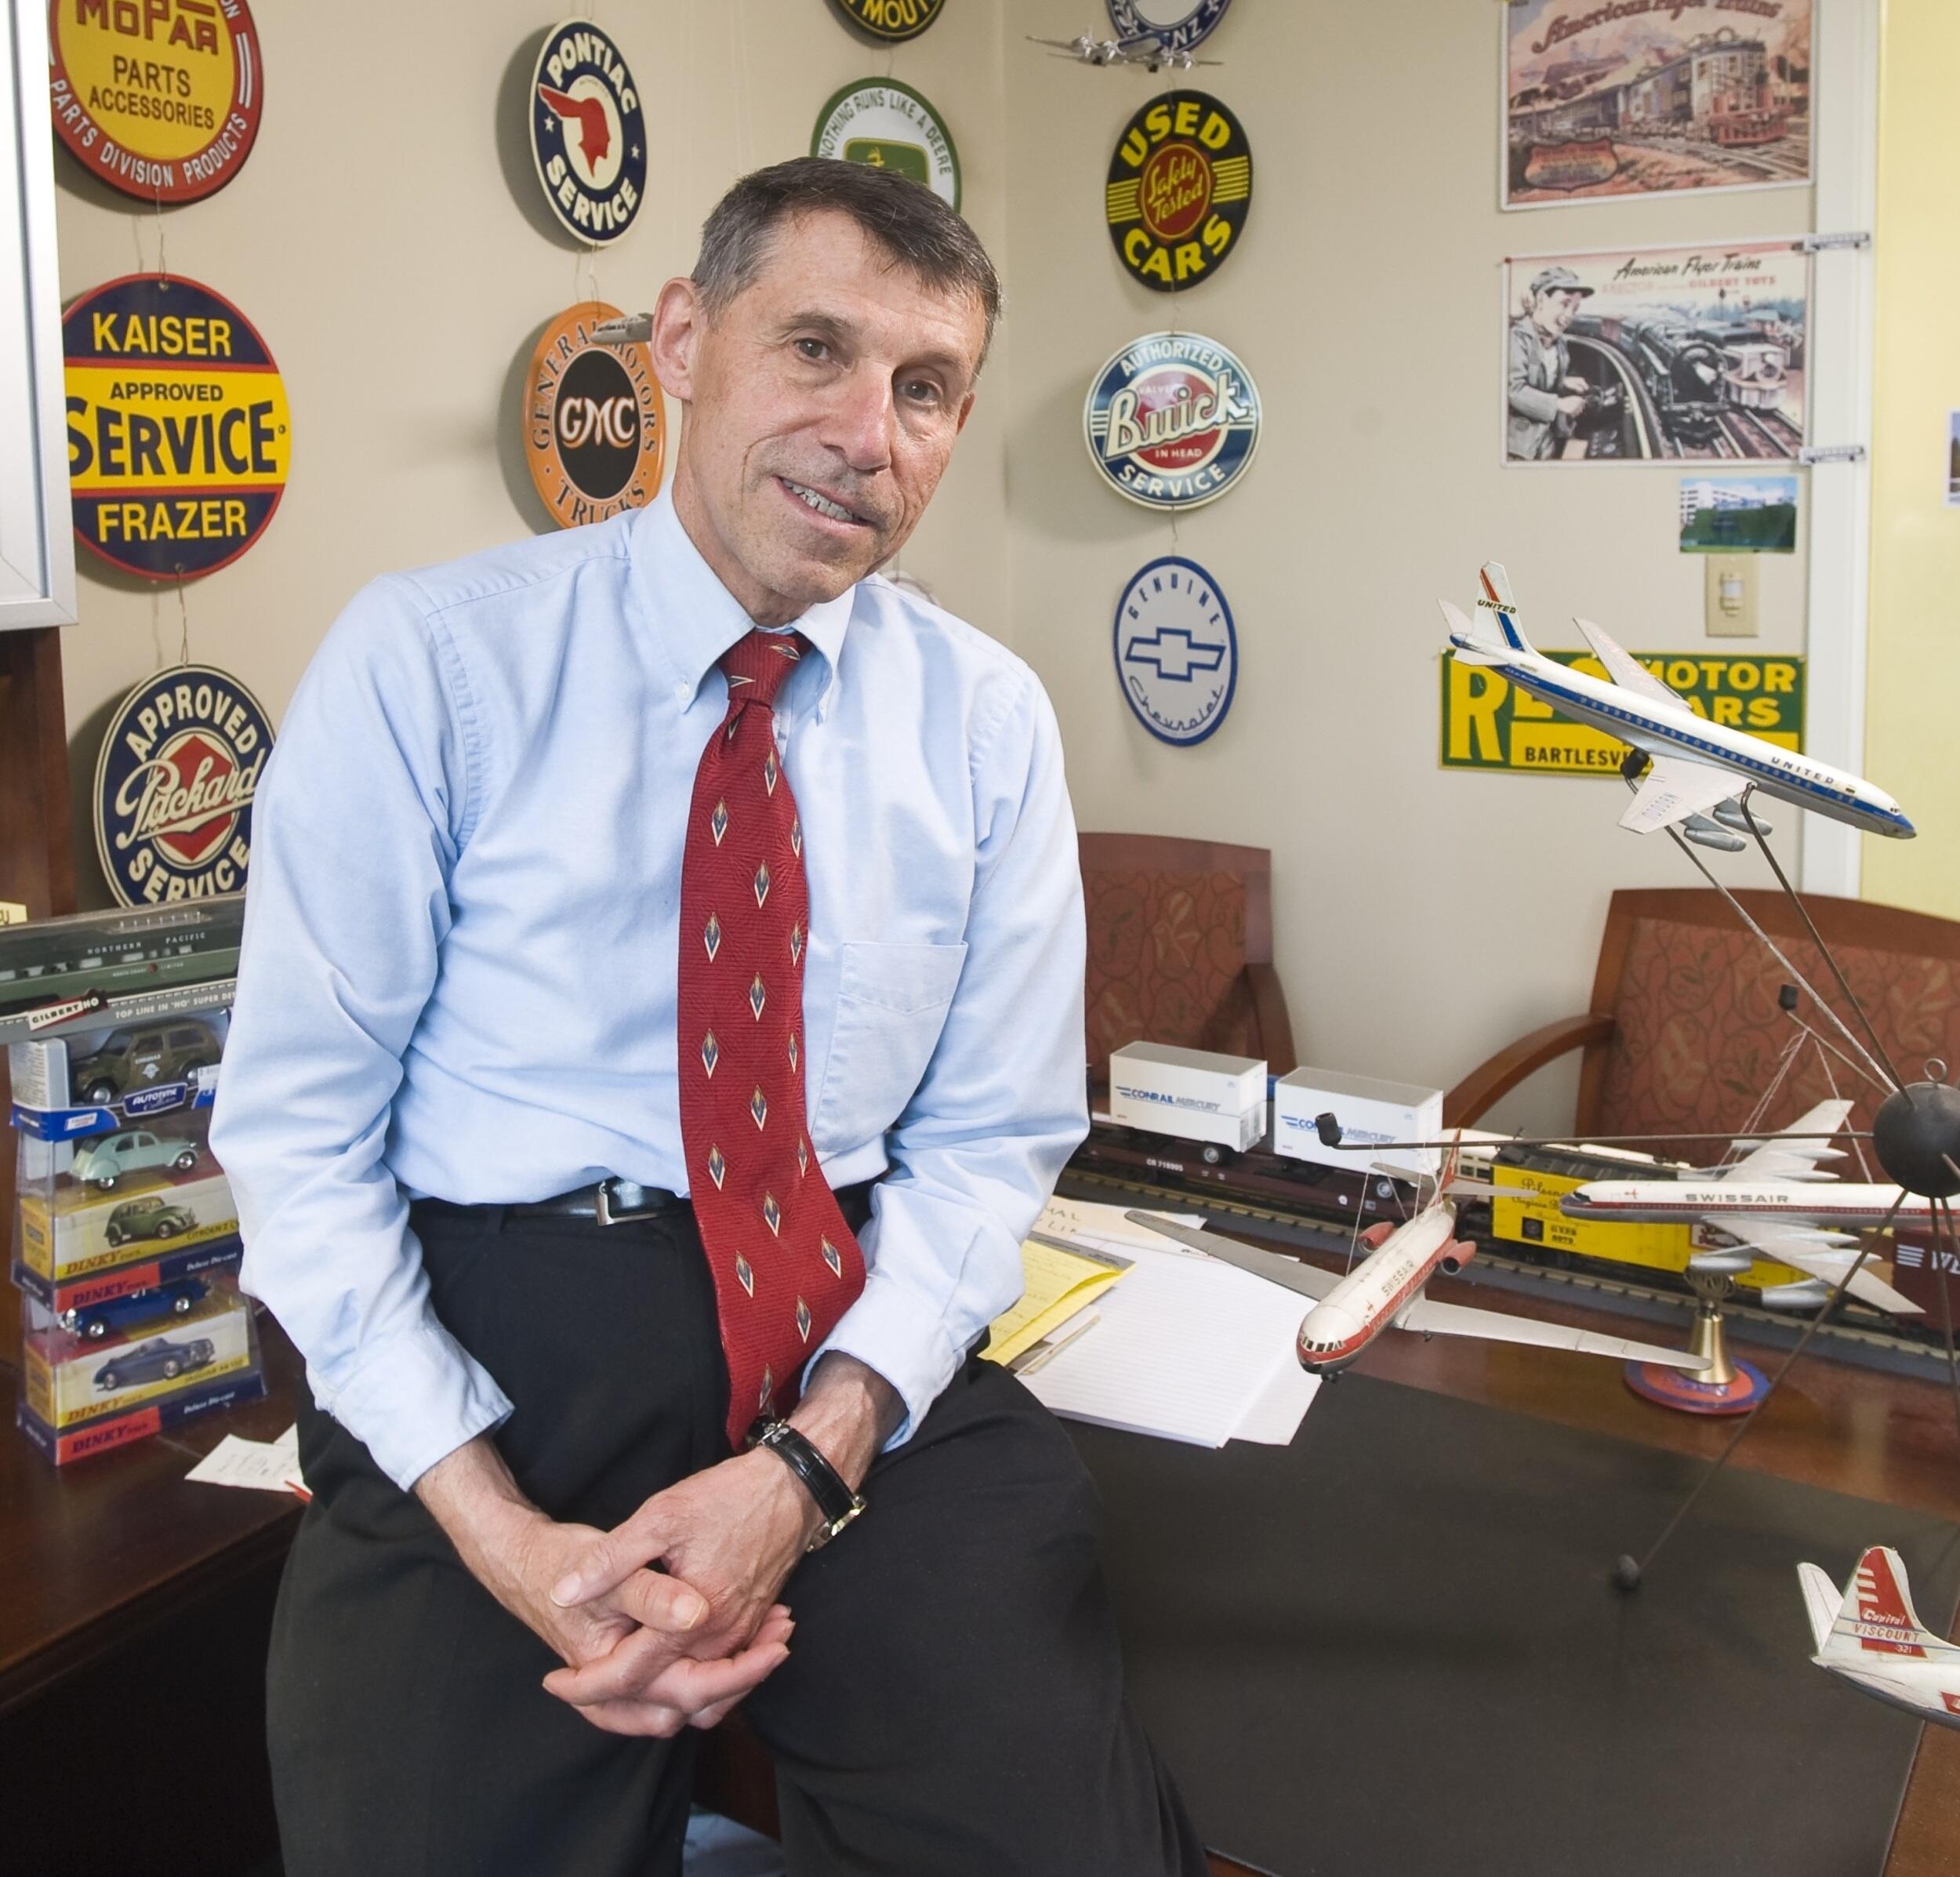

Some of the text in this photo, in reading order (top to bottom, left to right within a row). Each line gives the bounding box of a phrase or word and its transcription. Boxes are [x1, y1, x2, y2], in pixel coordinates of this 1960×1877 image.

[113, 55, 192, 98] PARTS
[546, 32, 637, 114] PONTIAC
[88, 85, 214, 130] ACCESSORIES
[50, 78, 248, 188] PARTS DIVISION PRODUCTS
[821, 89, 952, 176] NOTHING RUNS LIKE A DEERE
[1120, 101, 1231, 168] USED
[546, 154, 638, 231] SERVICE
[1147, 155, 1196, 204] Safety
[1152, 174, 1203, 224] Tested
[1124, 212, 1232, 282] CARS
[1613, 252, 1762, 281] American Flyer Trains
[92, 313, 232, 357] KAISER
[1120, 340, 1223, 377] AUTHORIZED
[110, 382, 224, 402] APPROVED
[559, 395, 637, 446] GMC
[1102, 371, 1250, 460] Buick
[67, 395, 278, 477] SERVICE
[1155, 448, 1202, 458] IN HEAD
[1118, 463, 1226, 499] SERVICE
[96, 499, 247, 543] FRAZER
[1127, 573, 1221, 625] GENUINE
[1477, 598, 1517, 614] UNITED
[1129, 675, 1225, 731] Chevrolet
[1690, 695, 1782, 728] ARS
[125, 684, 258, 763] APPROVED
[1771, 756, 1835, 785] UNITED
[114, 747, 267, 851] Packard
[128, 833, 250, 905] SERVICE
[86, 931, 206, 955] NORTHERN PACIFIC
[31, 997, 100, 1024] GILBERT HO
[115, 1009, 133, 1019] TOP
[136, 1006, 156, 1017] LINE
[158, 1003, 169, 1012] IN
[193, 995, 220, 1006] SUPER
[1131, 1089, 1221, 1113] CONRAIL MERCURY
[1346, 1127, 1397, 1145] MERCURY
[1685, 1193, 1789, 1204] SWISSAIR
[66, 1251, 120, 1275] DINKY
[73, 1279, 127, 1306] DINKY
[67, 1396, 123, 1422] DINKY
[73, 1424, 128, 1454] DINKY
[1853, 1624, 1921, 1643] VISCOUNT
[1863, 1607, 1906, 1625] Capital
[1896, 1643, 1912, 1654] 321
